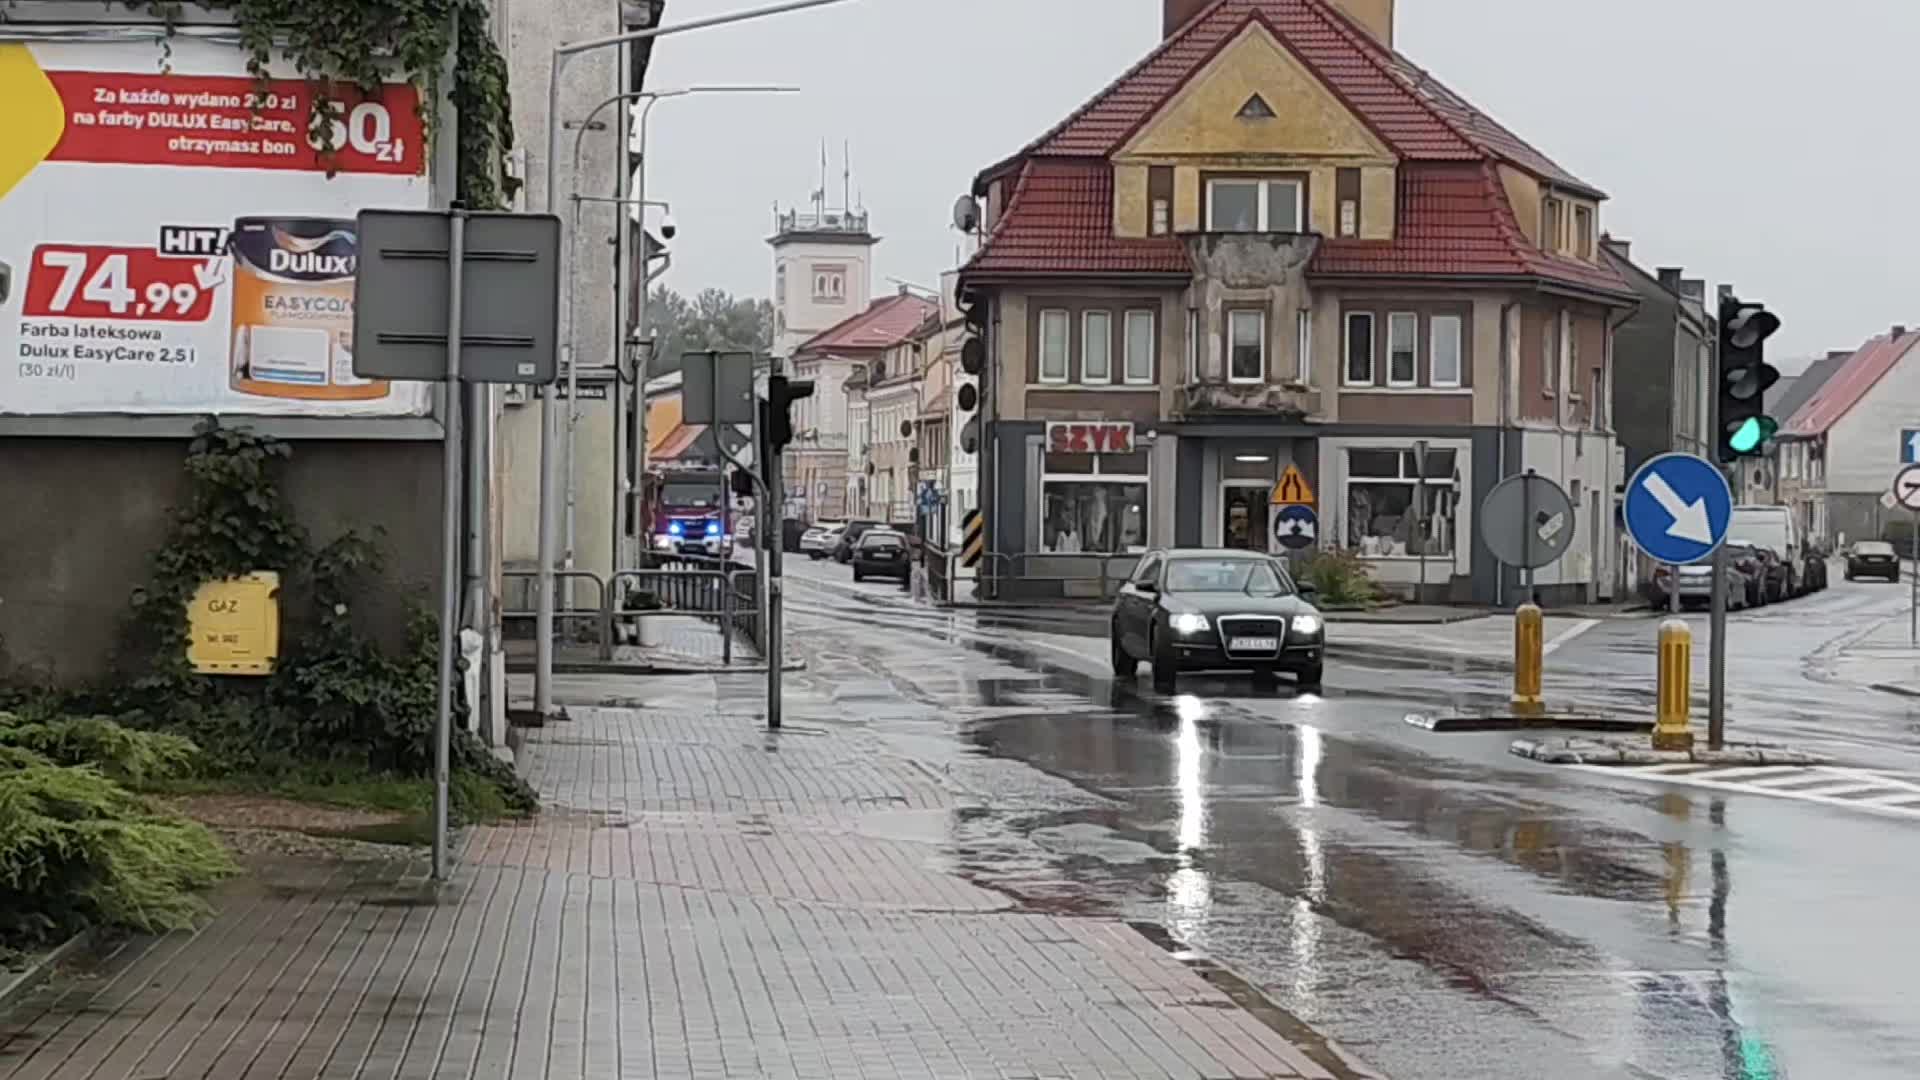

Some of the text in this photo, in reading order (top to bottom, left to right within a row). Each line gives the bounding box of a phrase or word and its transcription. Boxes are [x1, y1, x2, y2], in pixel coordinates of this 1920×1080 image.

[94, 88, 115, 103] Za
[119, 89, 170, 105] każde
[73, 112, 95, 125] na
[99, 111, 144, 130] farby
[148, 112, 207, 129] DULUX
[168, 136, 296, 155] otrzymasz bon
[164, 228, 227, 256] HIT!
[269, 248, 349, 274] Dulux
[42, 250, 198, 318] 74,99
[20, 322, 162, 341] Farba lateksowa
[19, 343, 69, 358] Dulux
[73, 344, 155, 363] EasyCare
[159, 347, 186, 363] 2,5
[18, 363, 43, 379] (30
[1049, 424, 1131, 451] SZYK
[208, 599, 239, 614] GAZ
